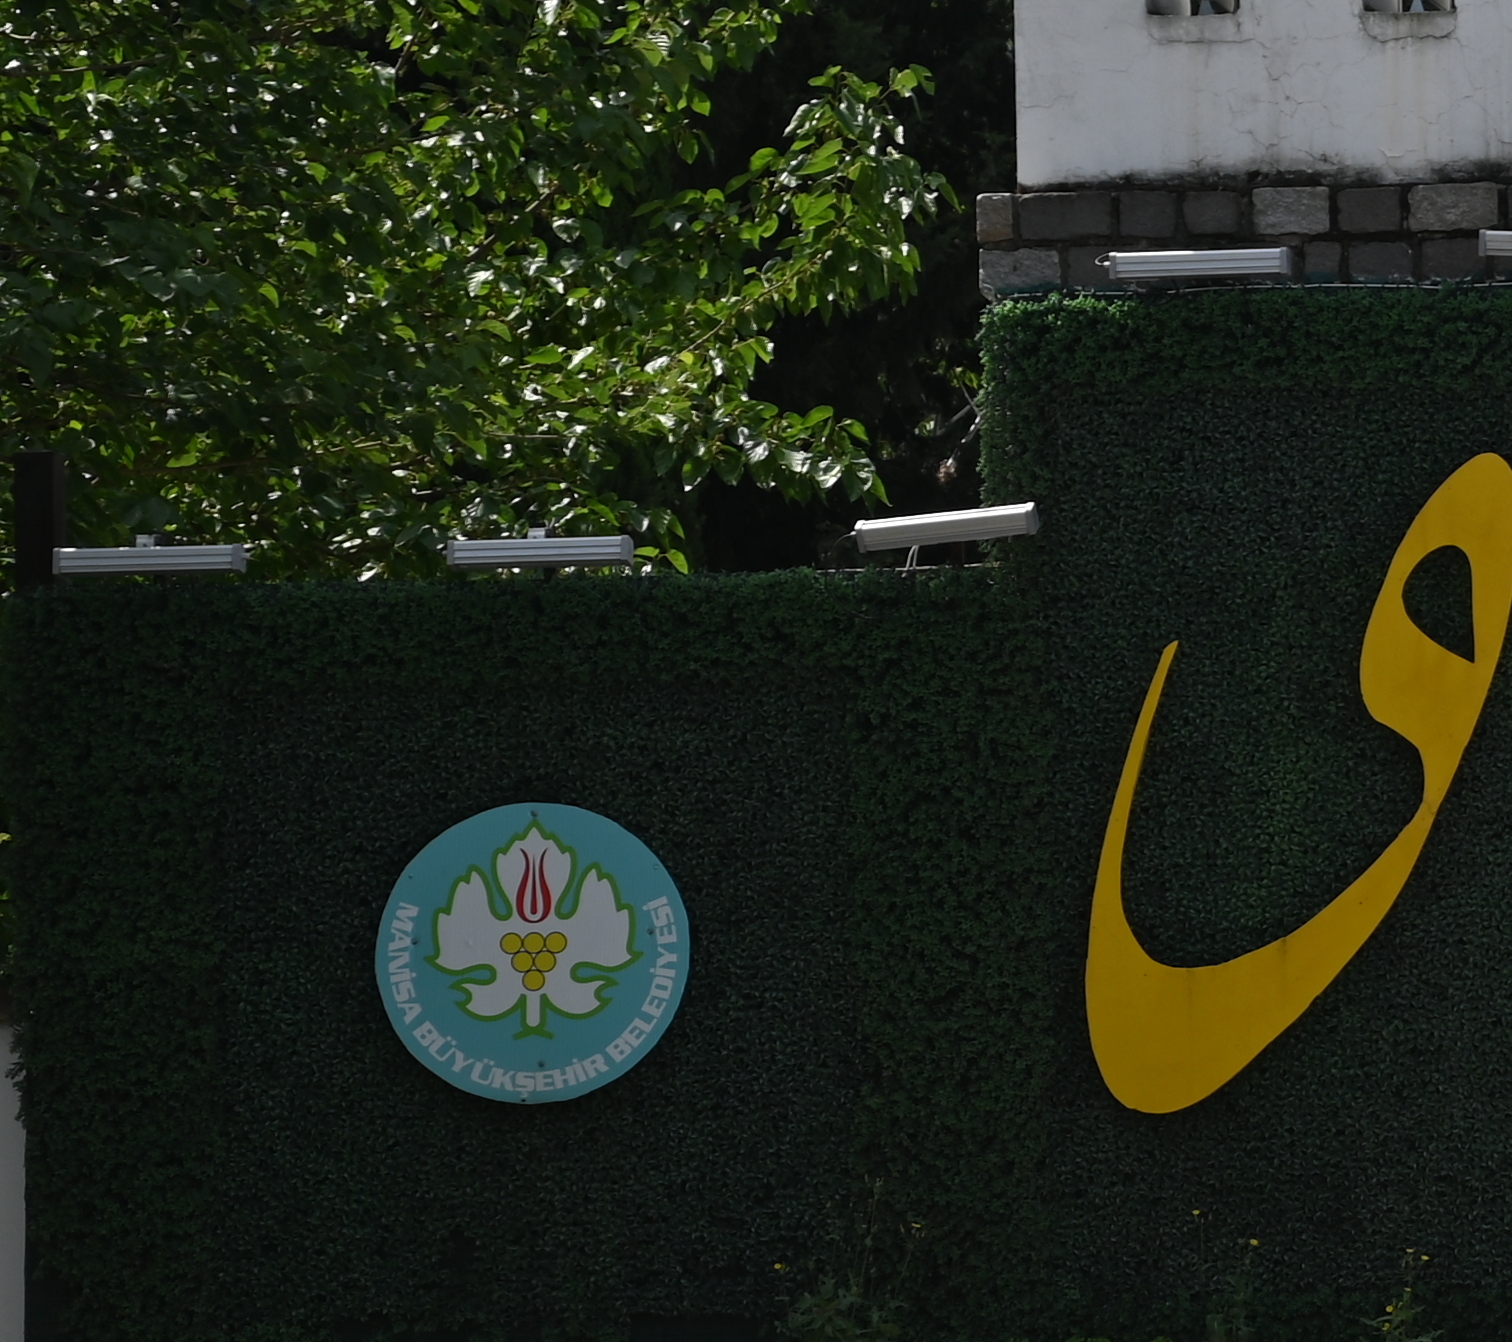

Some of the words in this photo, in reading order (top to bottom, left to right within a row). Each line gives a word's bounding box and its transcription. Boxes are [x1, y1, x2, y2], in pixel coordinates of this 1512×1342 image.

[387, 902, 422, 1025] MANİSA
[412, 1020, 610, 1098] BÜYÜKŞEHİR
[605, 895, 678, 1063] BELEDİYESİ
